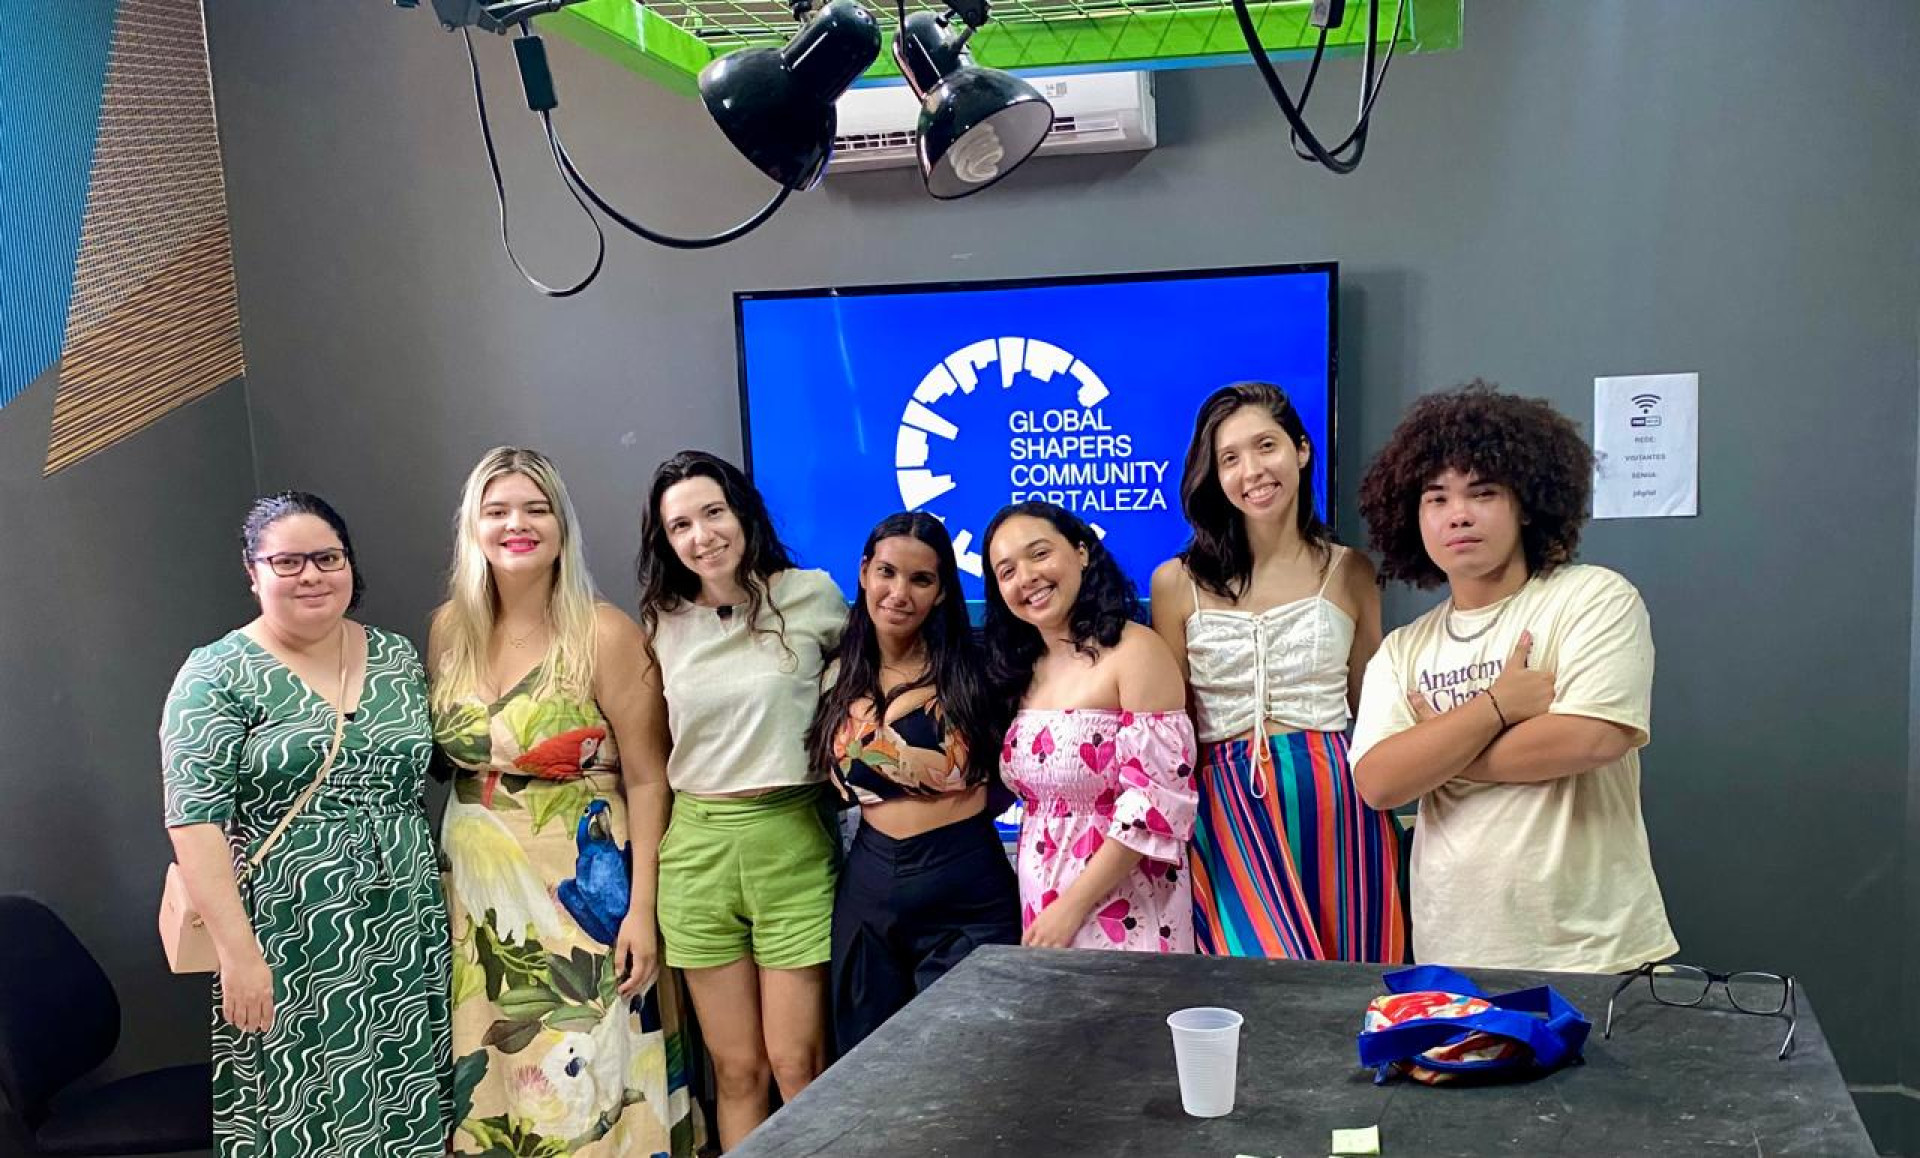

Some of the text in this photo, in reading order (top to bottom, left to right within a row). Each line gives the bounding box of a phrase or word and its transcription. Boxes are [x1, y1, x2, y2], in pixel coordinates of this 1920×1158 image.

[1009, 408, 1112, 432] GLOBAL
[1010, 435, 1132, 459] SHAPERS
[1010, 461, 1169, 486] COMMUNITY
[1011, 489, 1168, 512] FORTALEZA
